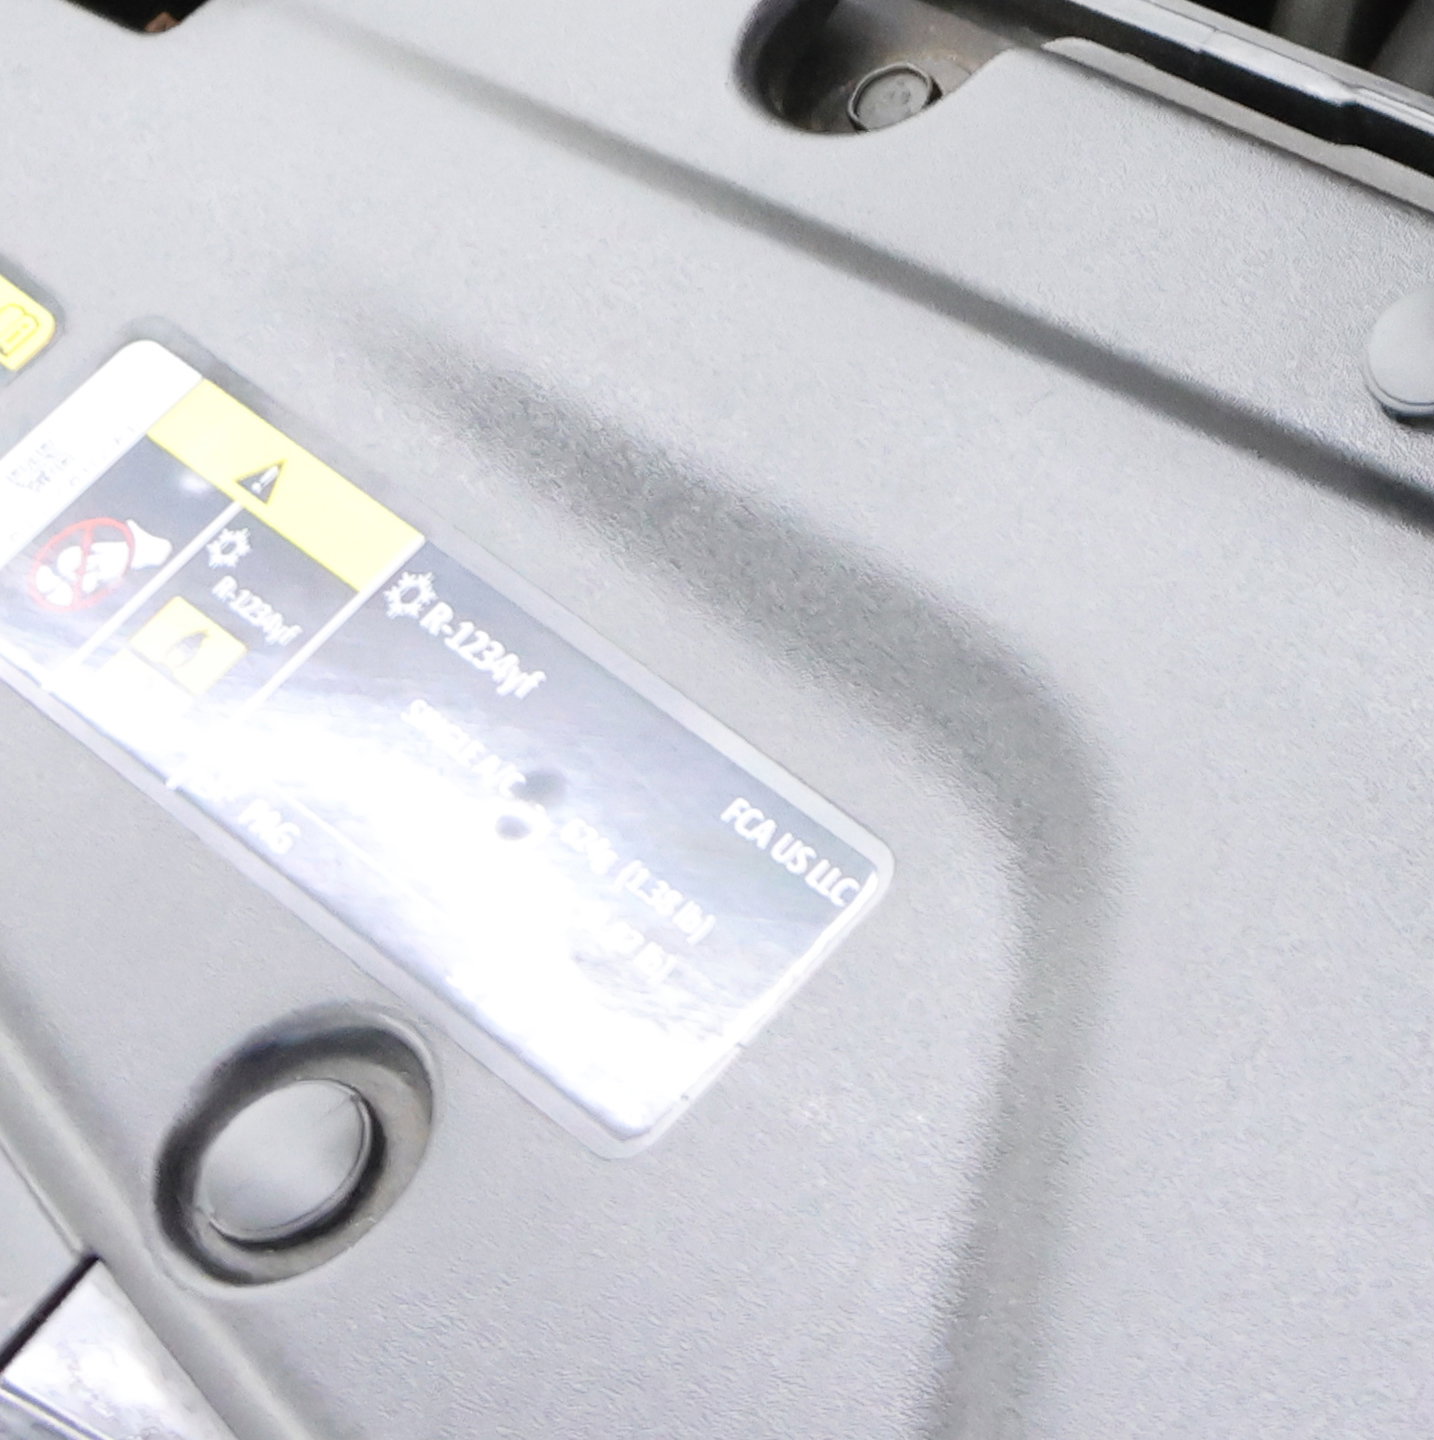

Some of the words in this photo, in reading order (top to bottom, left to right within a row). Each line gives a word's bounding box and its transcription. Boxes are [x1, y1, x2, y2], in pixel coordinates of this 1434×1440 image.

[210, 574, 302, 648] R-1234yf
[418, 600, 547, 700] R-1234yf
[720, 796, 777, 850] FCA
[770, 832, 817, 874] US
[804, 858, 862, 908] LLC
